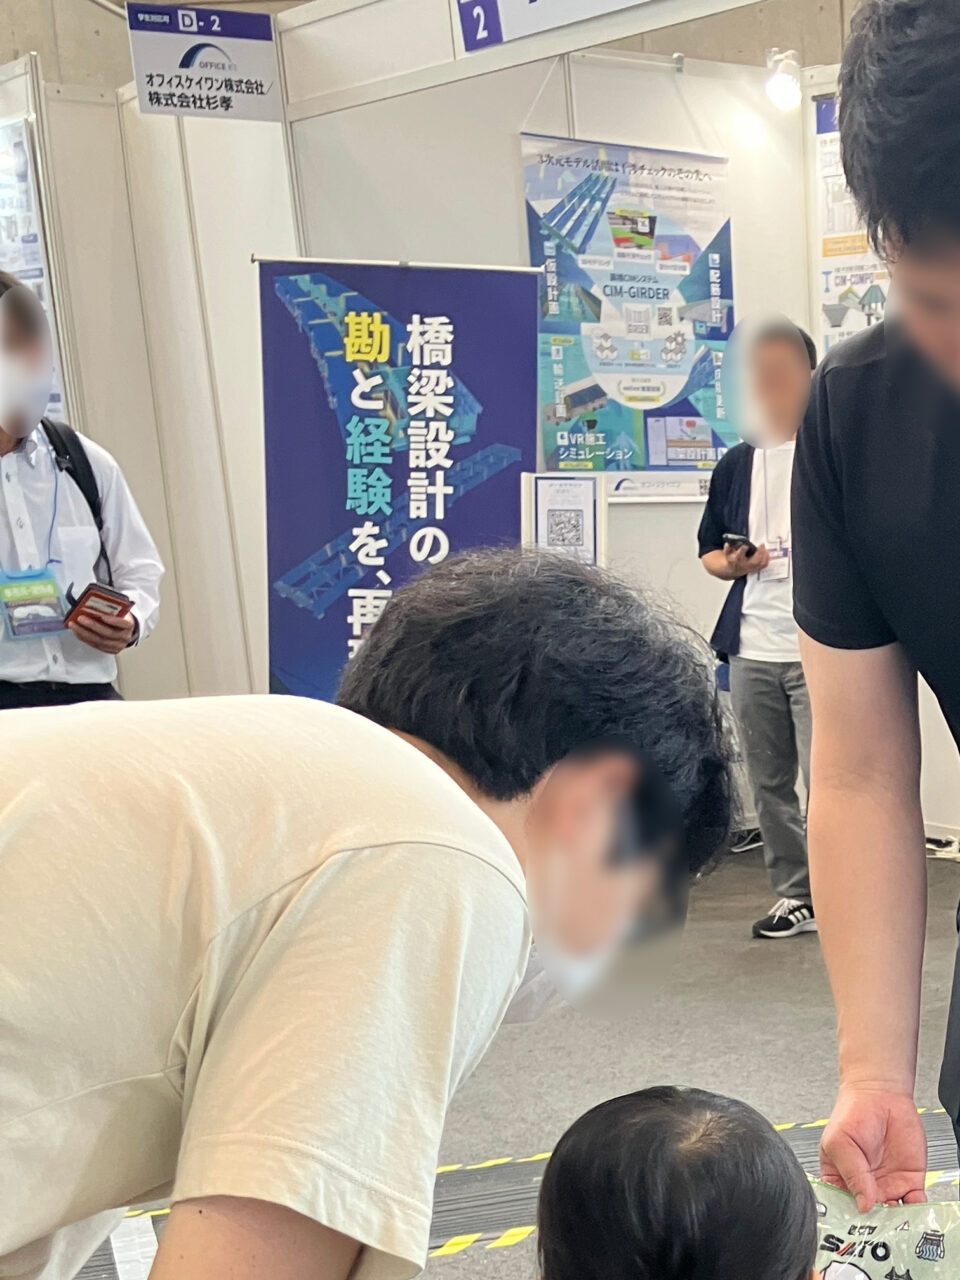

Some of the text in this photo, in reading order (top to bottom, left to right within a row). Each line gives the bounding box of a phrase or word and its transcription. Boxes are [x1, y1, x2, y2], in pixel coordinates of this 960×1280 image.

[199, 62, 226, 71] OFFICE
[602, 285, 670, 300] CIM-GIRDER
[406, 313, 454, 565] 橋梁設計の
[570, 433, 606, 446] VR施工
[558, 449, 633, 461] シミュレーション
[343, 311, 393, 660] 勘と経験を、再
[819, 1234, 890, 1262] SATO
